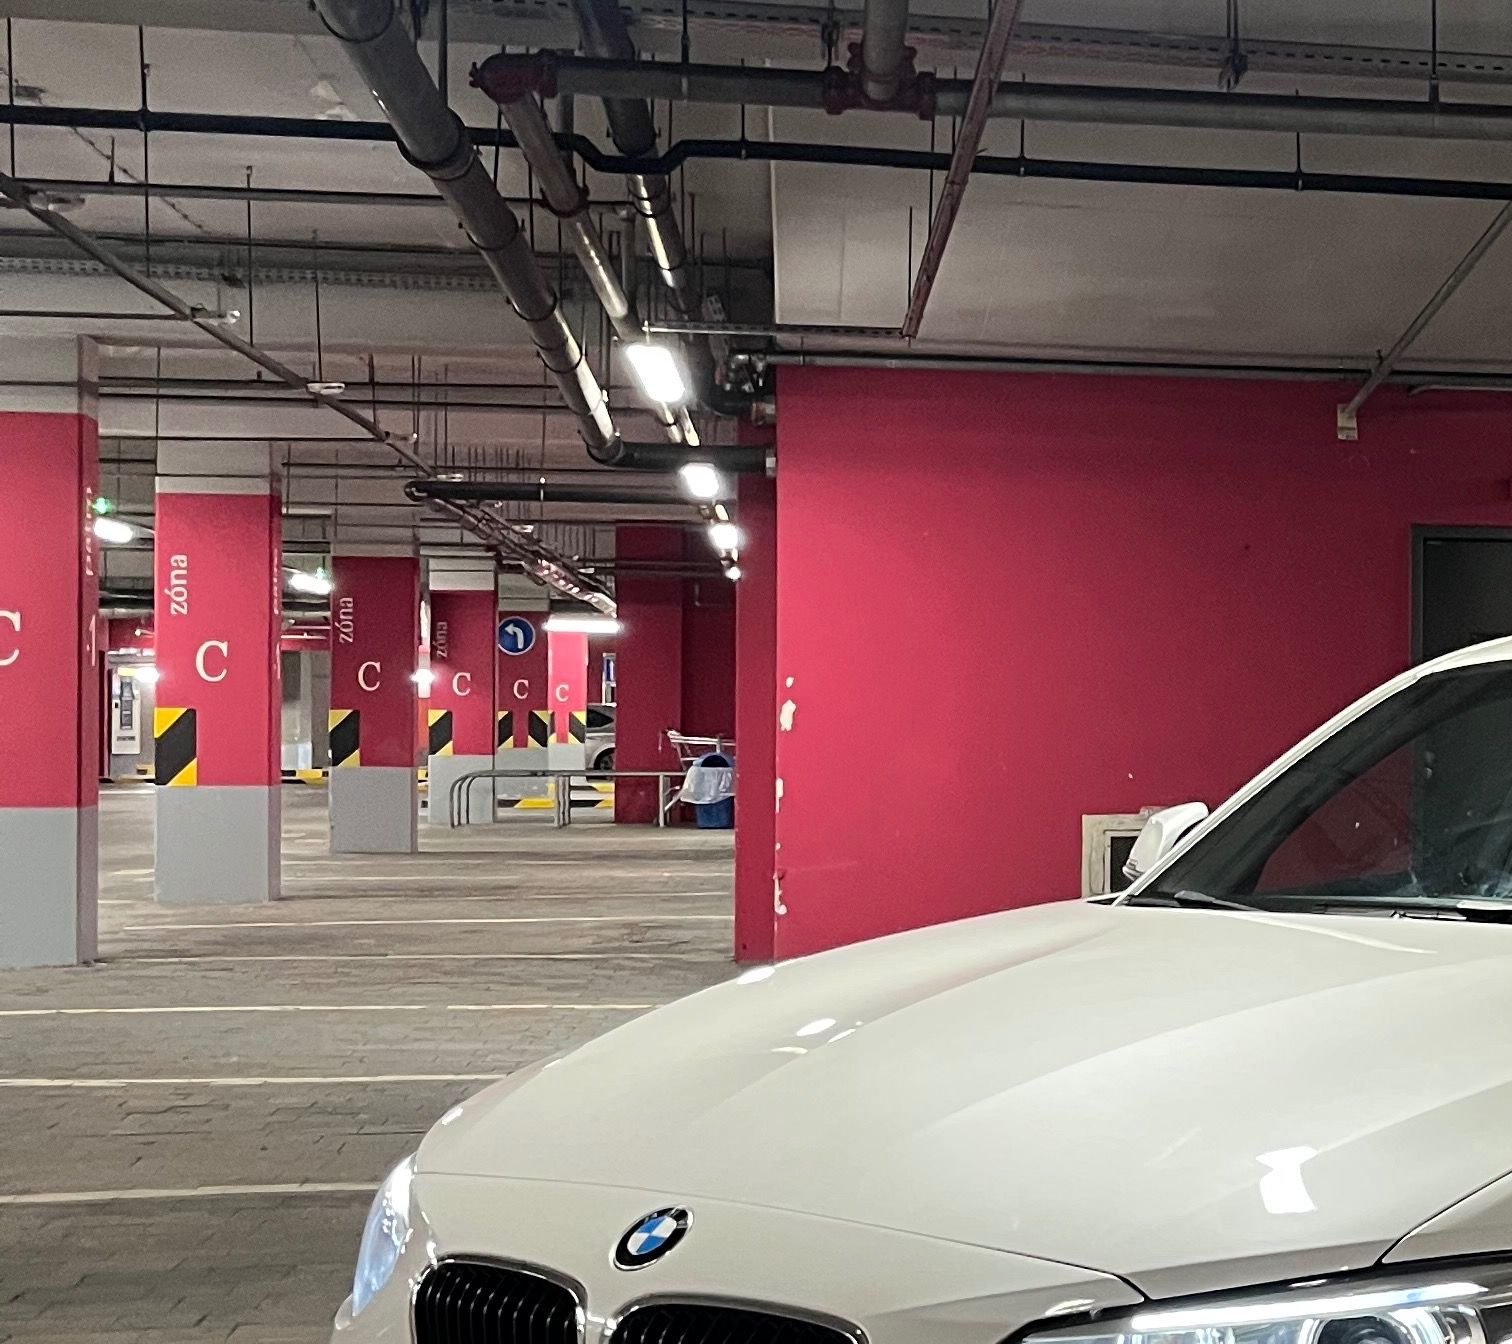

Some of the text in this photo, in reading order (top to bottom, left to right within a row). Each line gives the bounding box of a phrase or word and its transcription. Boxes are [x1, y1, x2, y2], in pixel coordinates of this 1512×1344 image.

[164, 554, 187, 615] zóna
[334, 597, 353, 644] zóna
[195, 640, 228, 682] C
[358, 661, 380, 691] C
[452, 672, 471, 696] C
[513, 679, 529, 699] C
[555, 684, 569, 702] C
